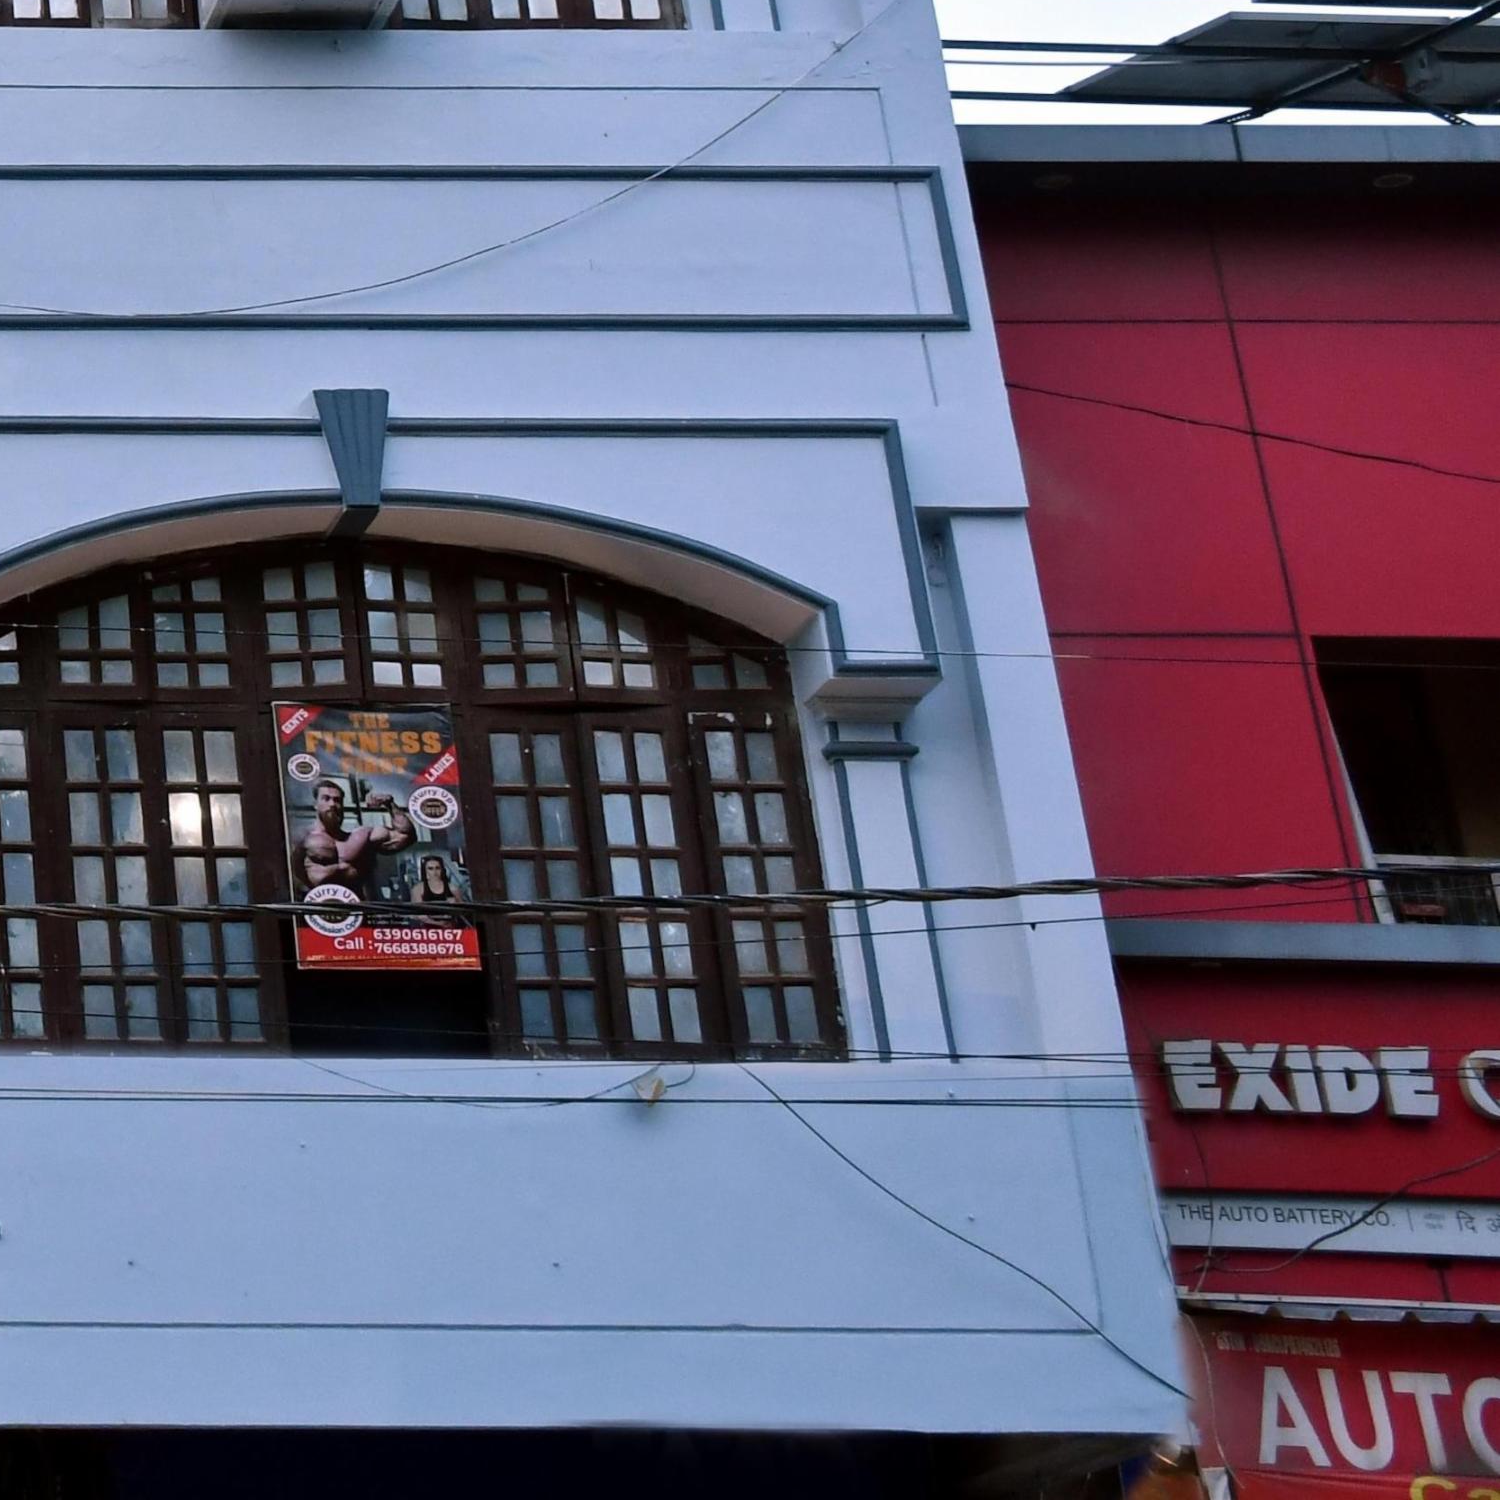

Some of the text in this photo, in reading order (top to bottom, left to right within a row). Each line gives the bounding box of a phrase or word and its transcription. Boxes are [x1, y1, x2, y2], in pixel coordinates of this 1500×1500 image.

[348, 712, 390, 729] THE
[304, 730, 442, 754] FITNESS
[373, 928, 462, 940] 6390616167
[334, 937, 364, 950] Call
[374, 942, 464, 955] 7668388678
[1163, 1039, 1440, 1117] EXIDE
[1177, 1203, 1396, 1227] THE AUTO BATTERY CO.
